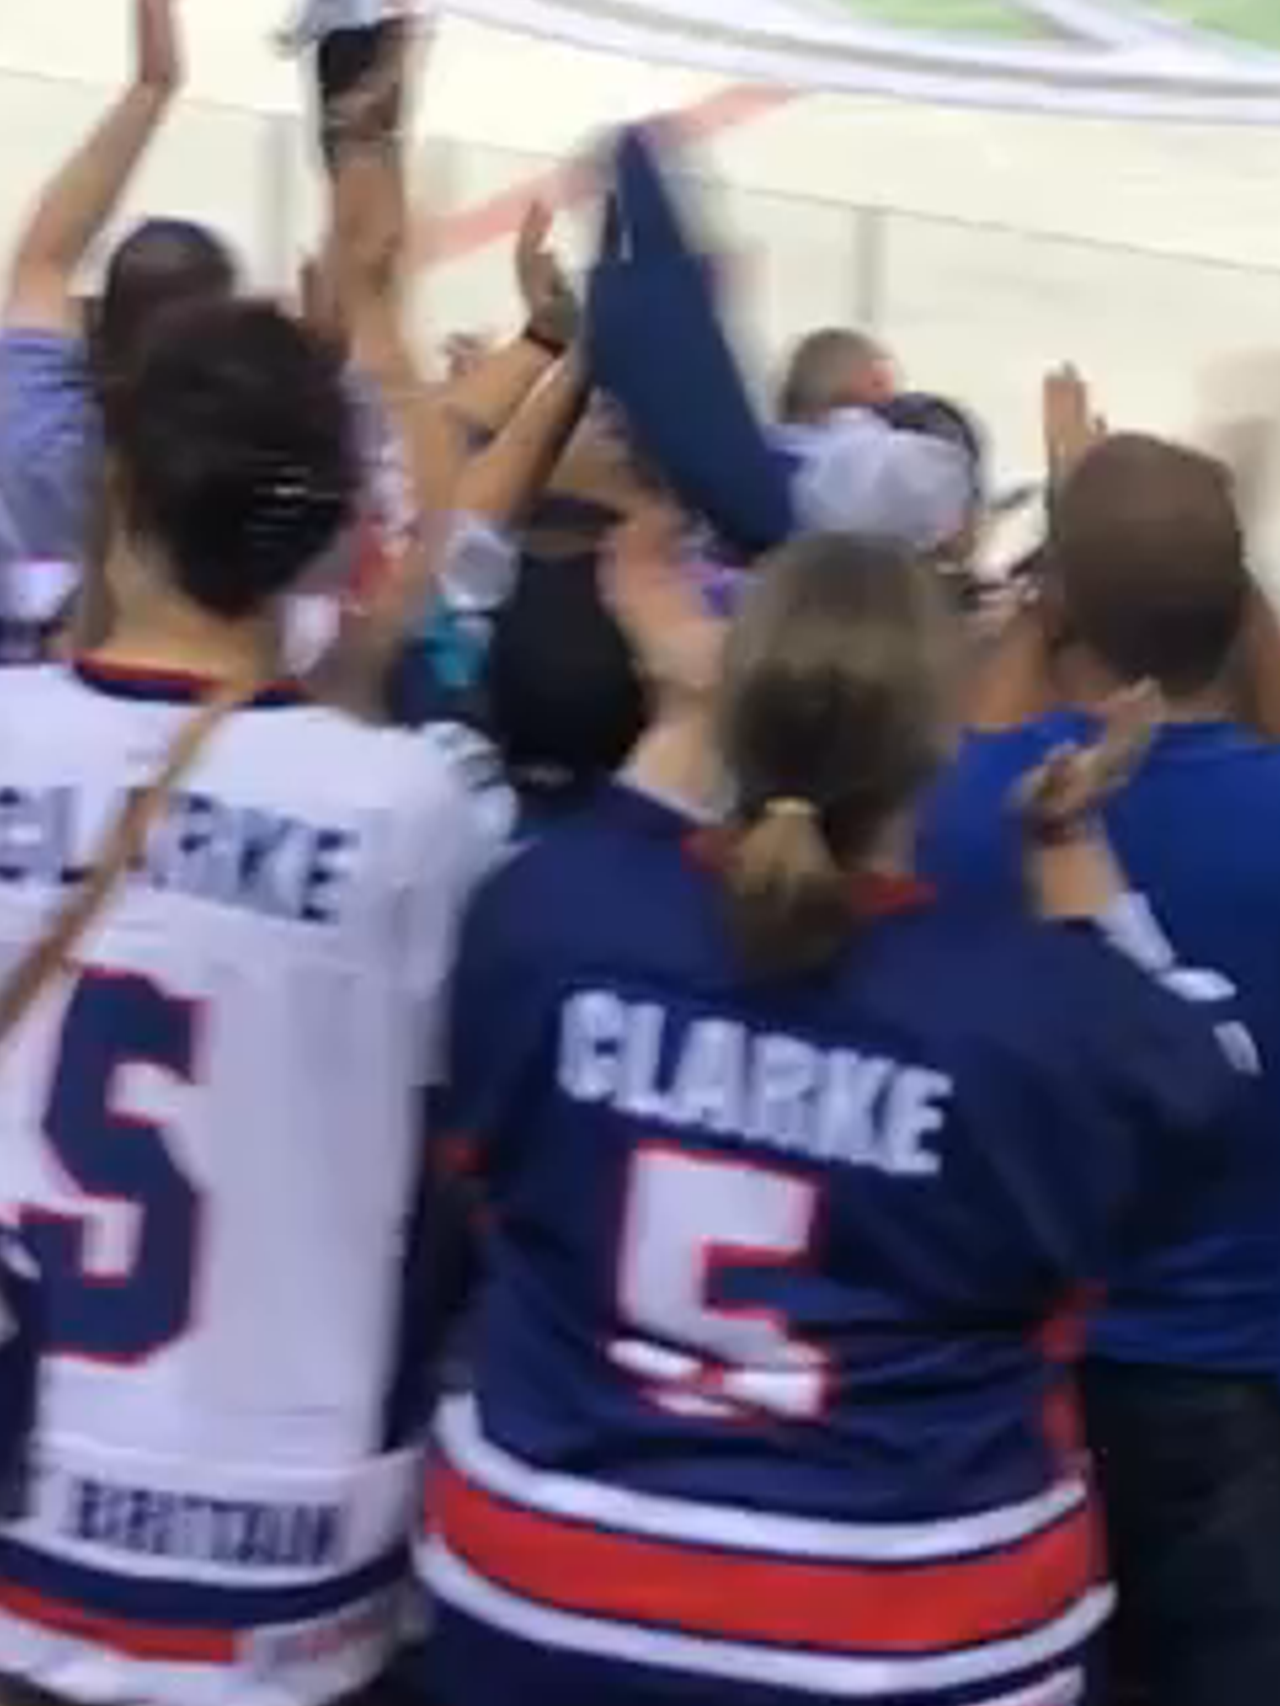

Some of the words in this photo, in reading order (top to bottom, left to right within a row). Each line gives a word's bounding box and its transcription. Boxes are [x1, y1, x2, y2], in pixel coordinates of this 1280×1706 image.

[20, 964, 206, 1368] 5
[556, 990, 954, 1176] CLARKE
[602, 1139, 833, 1424] 5
